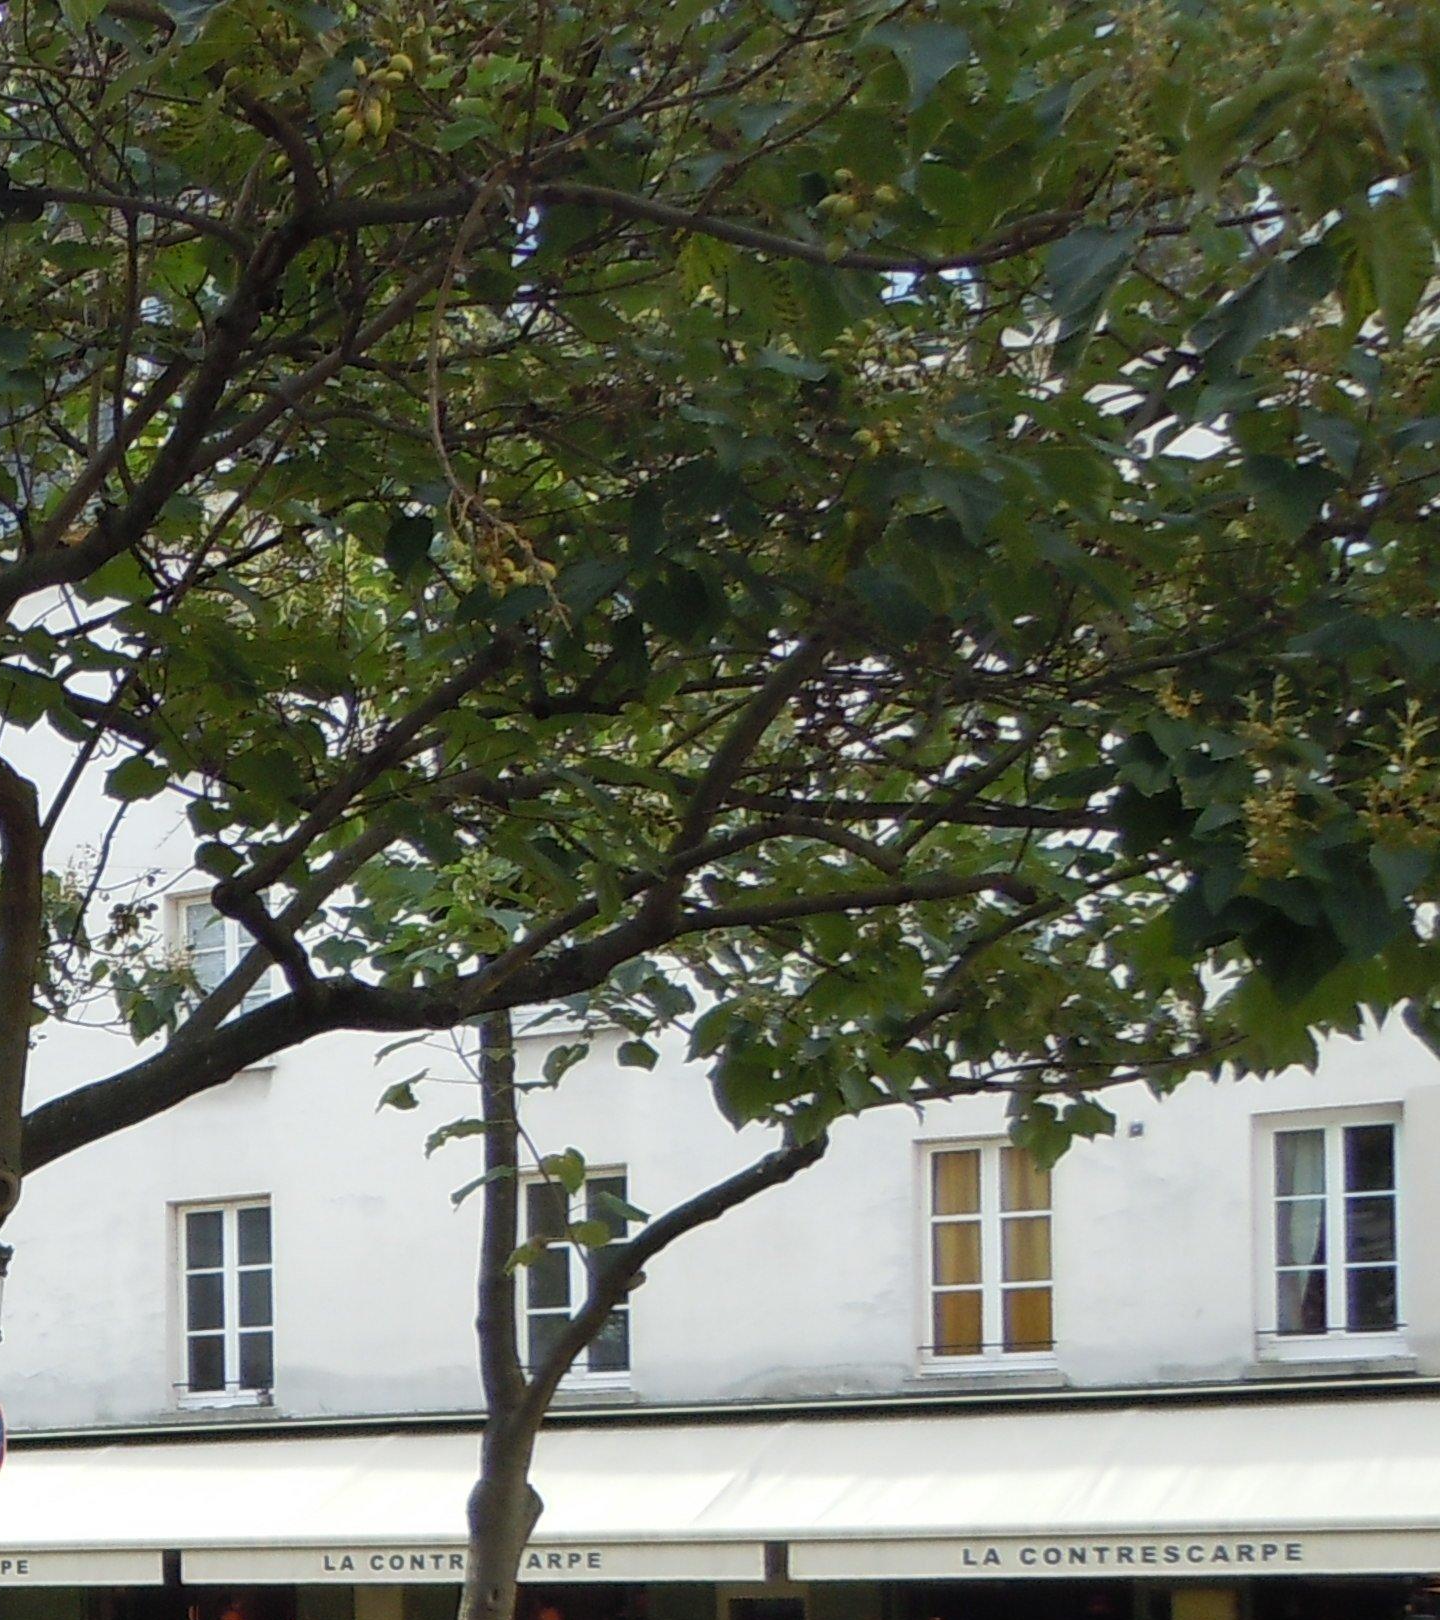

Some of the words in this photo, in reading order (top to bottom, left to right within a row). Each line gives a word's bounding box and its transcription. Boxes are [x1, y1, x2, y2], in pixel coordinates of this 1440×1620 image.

[324, 1554, 355, 1571] LA
[369, 1552, 602, 1571] CONTRARPE
[963, 1547, 1001, 1566] LA
[1021, 1543, 1303, 1565] CONTRESCARPE
